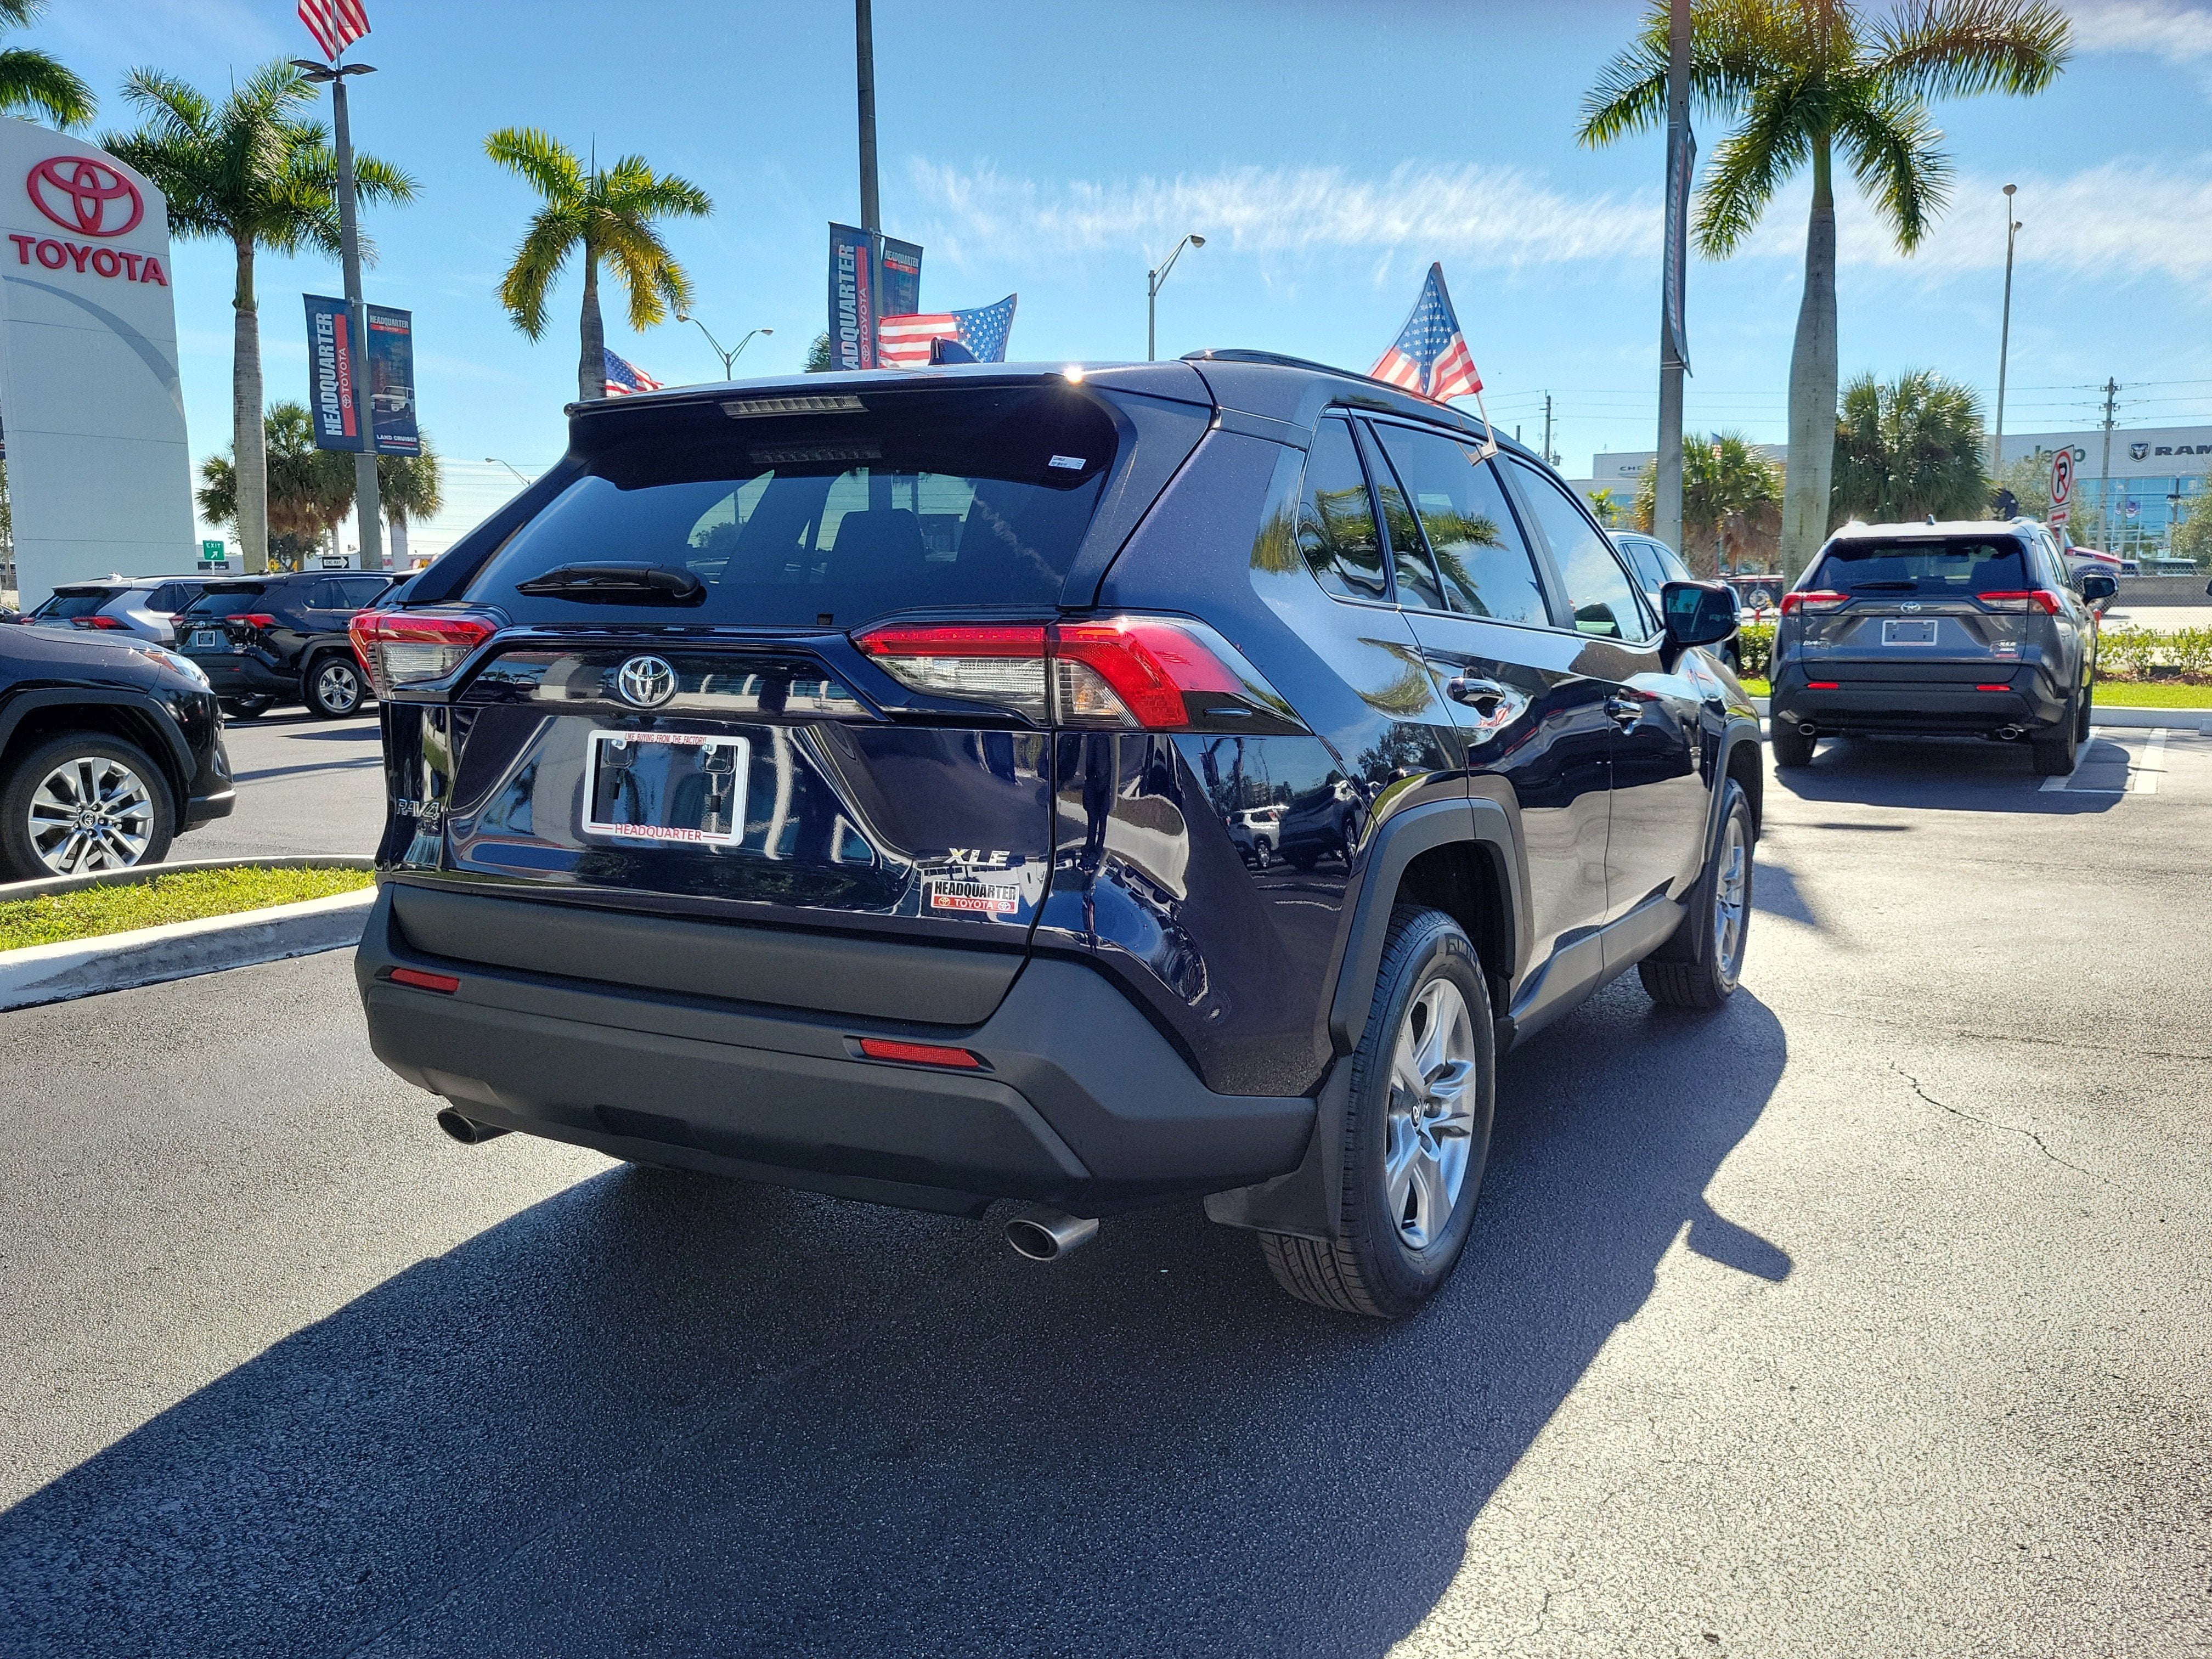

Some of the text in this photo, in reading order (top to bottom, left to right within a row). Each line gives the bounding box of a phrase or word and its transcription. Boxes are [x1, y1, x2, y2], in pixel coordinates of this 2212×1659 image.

[9, 234, 168, 286] TOYOTA
[885, 250, 918, 267] HEADQUARTER
[838, 244, 860, 370] ADQUARTER
[858, 287, 869, 342] TOYOTA
[370, 315, 409, 329] HEADQUARTER
[315, 313, 343, 436] HEADQUARTER
[338, 348, 349, 393] TOYOTA
[2154, 445, 2212, 456] RAM
[656, 735, 670, 743] FROM
[673, 735, 682, 743] THE
[683, 736, 707, 744] FACTORY!
[397, 798, 441, 820] RAV4
[615, 825, 702, 841] HEADQUARTER
[943, 848, 1011, 867] XLE
[934, 881, 1016, 900] HEADQUARTER
[954, 899, 994, 910] TOYOTA
